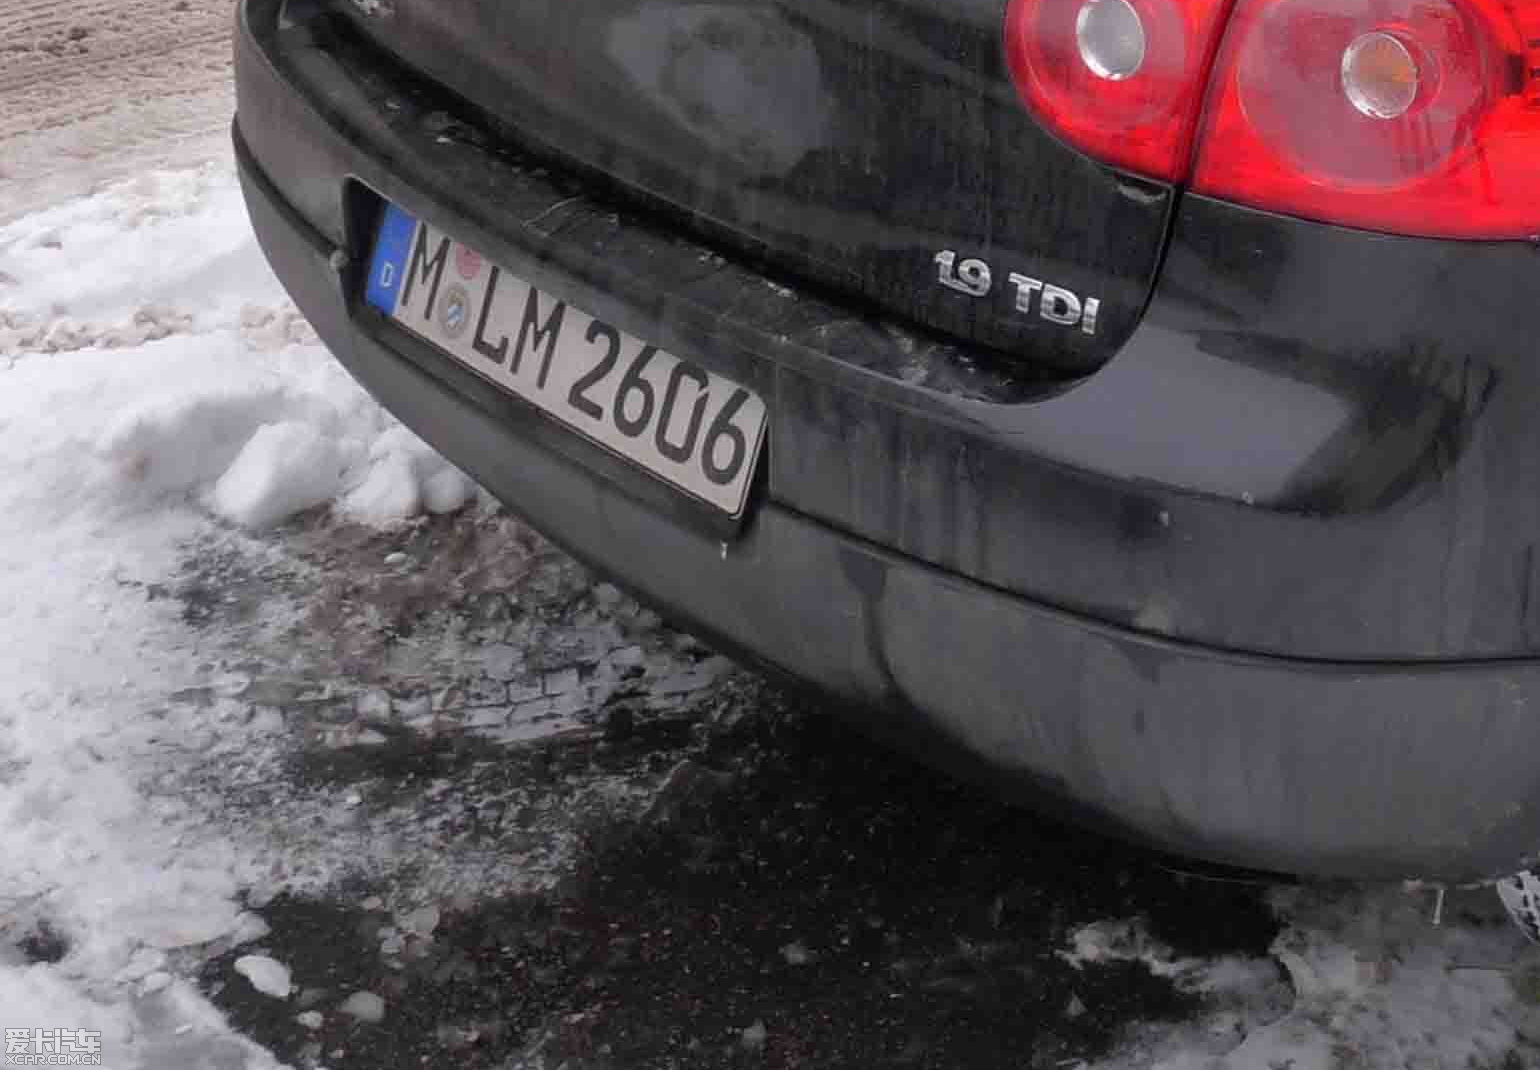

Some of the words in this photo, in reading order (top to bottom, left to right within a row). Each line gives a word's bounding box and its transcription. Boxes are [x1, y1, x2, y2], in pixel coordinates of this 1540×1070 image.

[401, 220, 452, 320] M
[471, 263, 567, 390] LM
[567, 318, 751, 486] 2606
[1008, 272, 1100, 335] TDI
